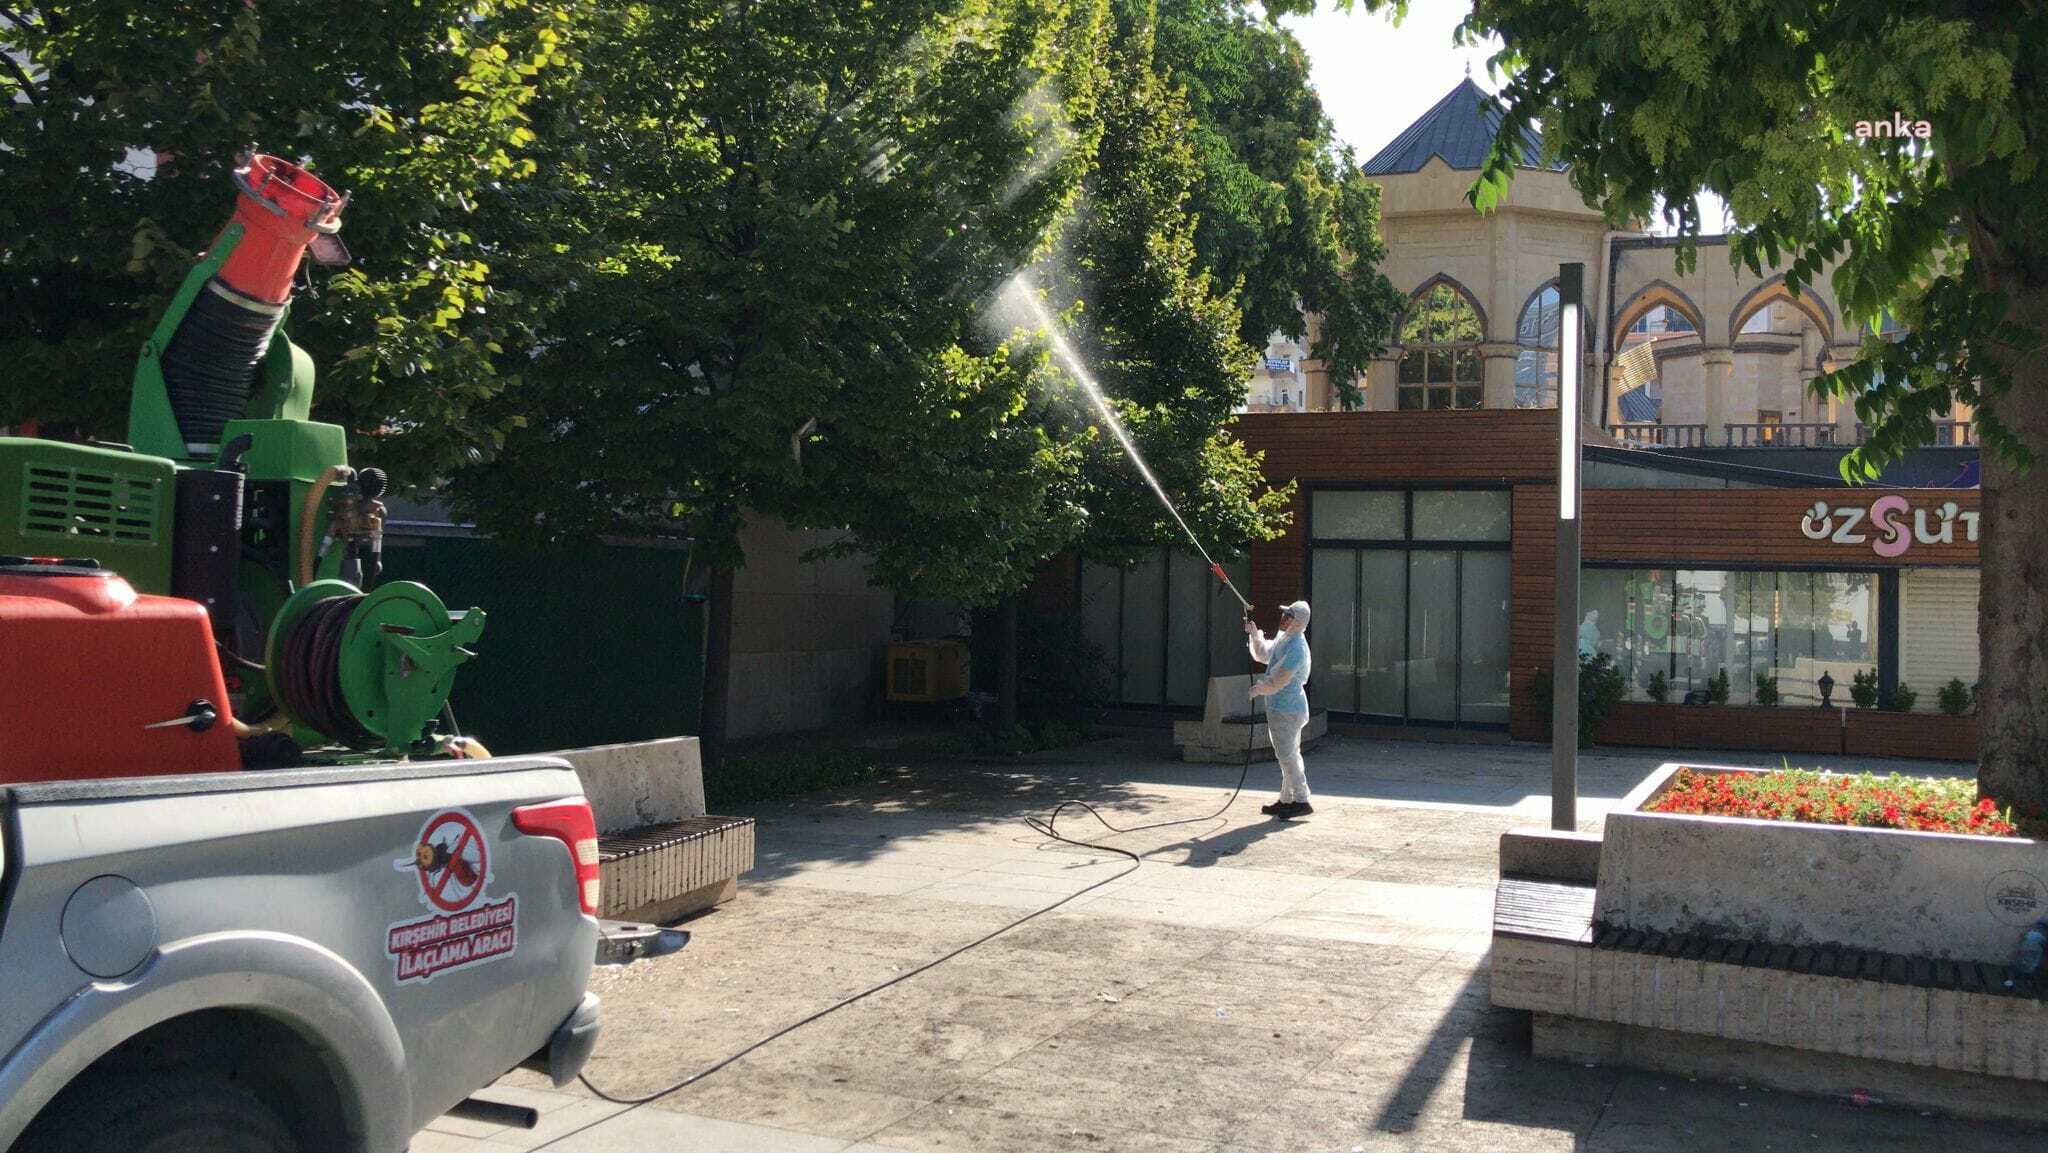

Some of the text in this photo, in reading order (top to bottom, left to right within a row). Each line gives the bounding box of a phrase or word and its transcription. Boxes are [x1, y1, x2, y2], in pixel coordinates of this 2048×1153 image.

[391, 902, 512, 949] KIRŞEHİR BELEDİYESİ
[400, 929, 513, 976] İLAÇLAMA ARACI
